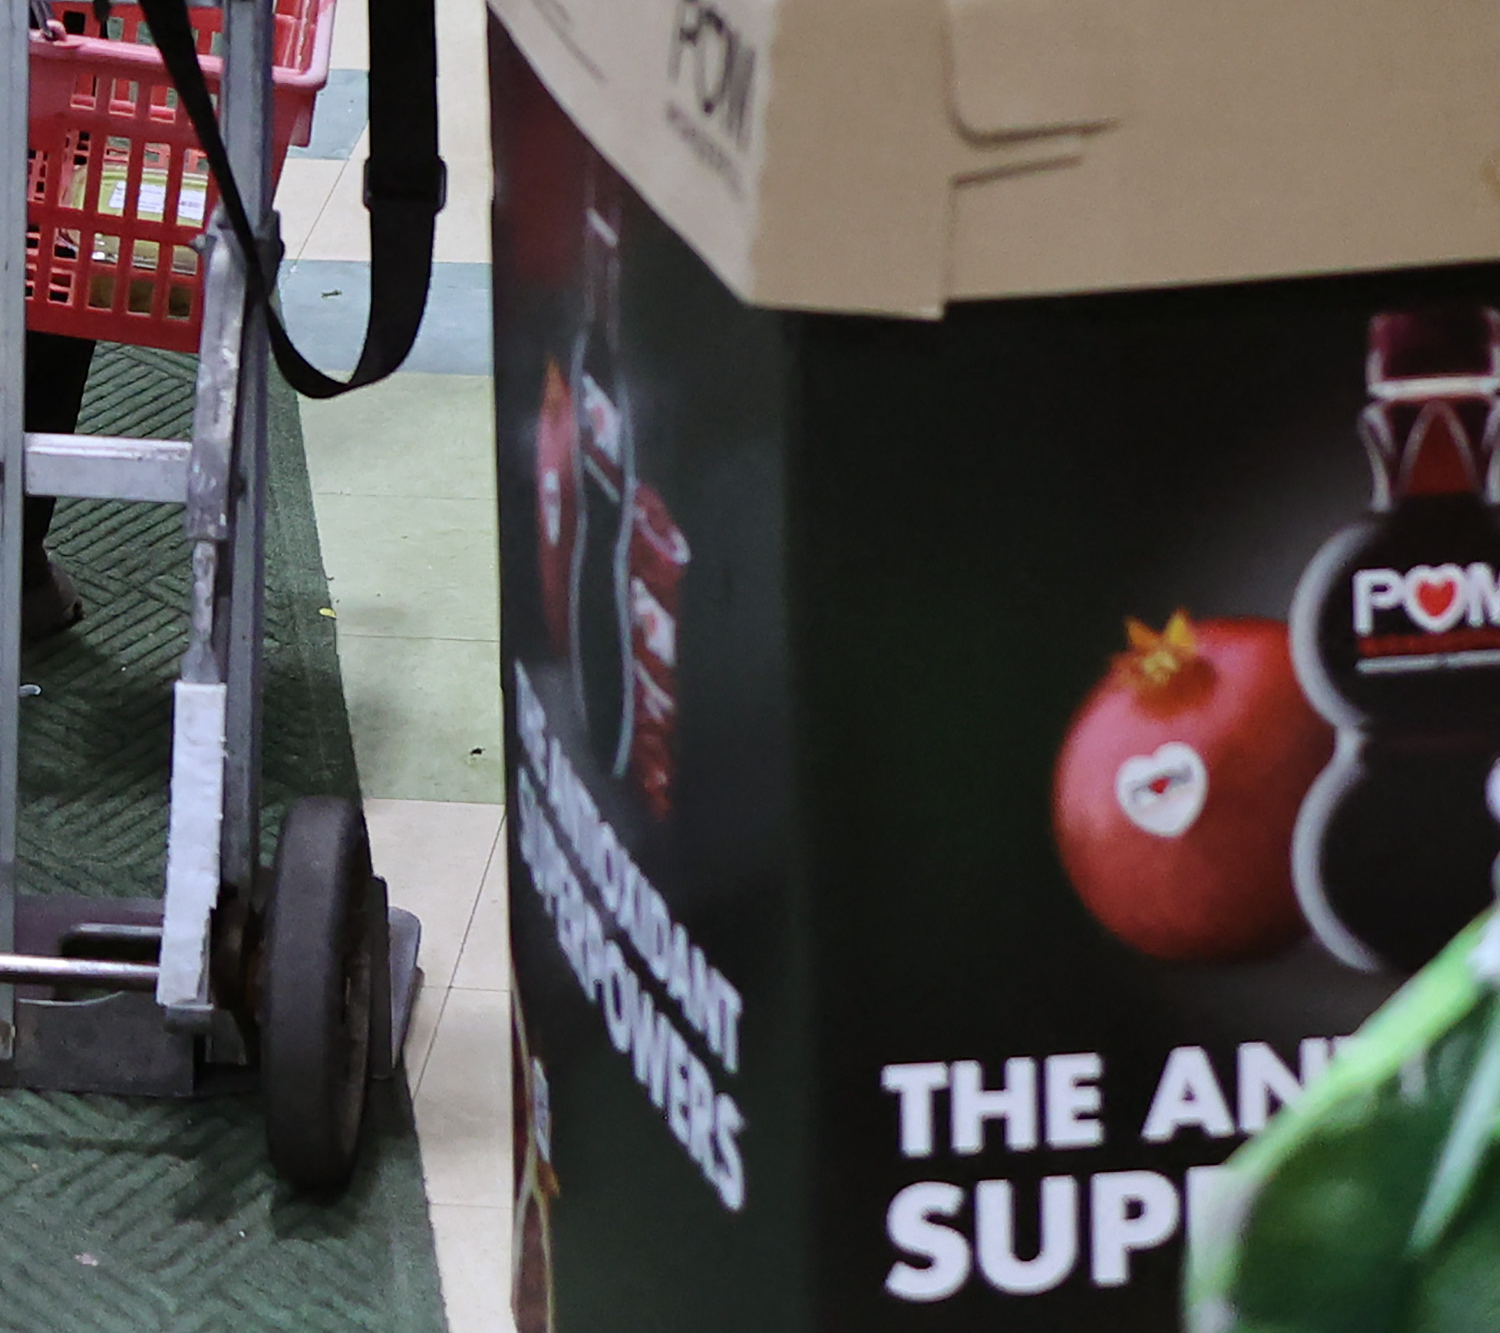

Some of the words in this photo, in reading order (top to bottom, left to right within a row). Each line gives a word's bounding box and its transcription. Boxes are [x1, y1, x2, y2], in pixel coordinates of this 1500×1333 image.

[517, 763, 746, 1213] SUPERPOWERS
[881, 1052, 1104, 1158] THE
[885, 1165, 1244, 1304] SUP
